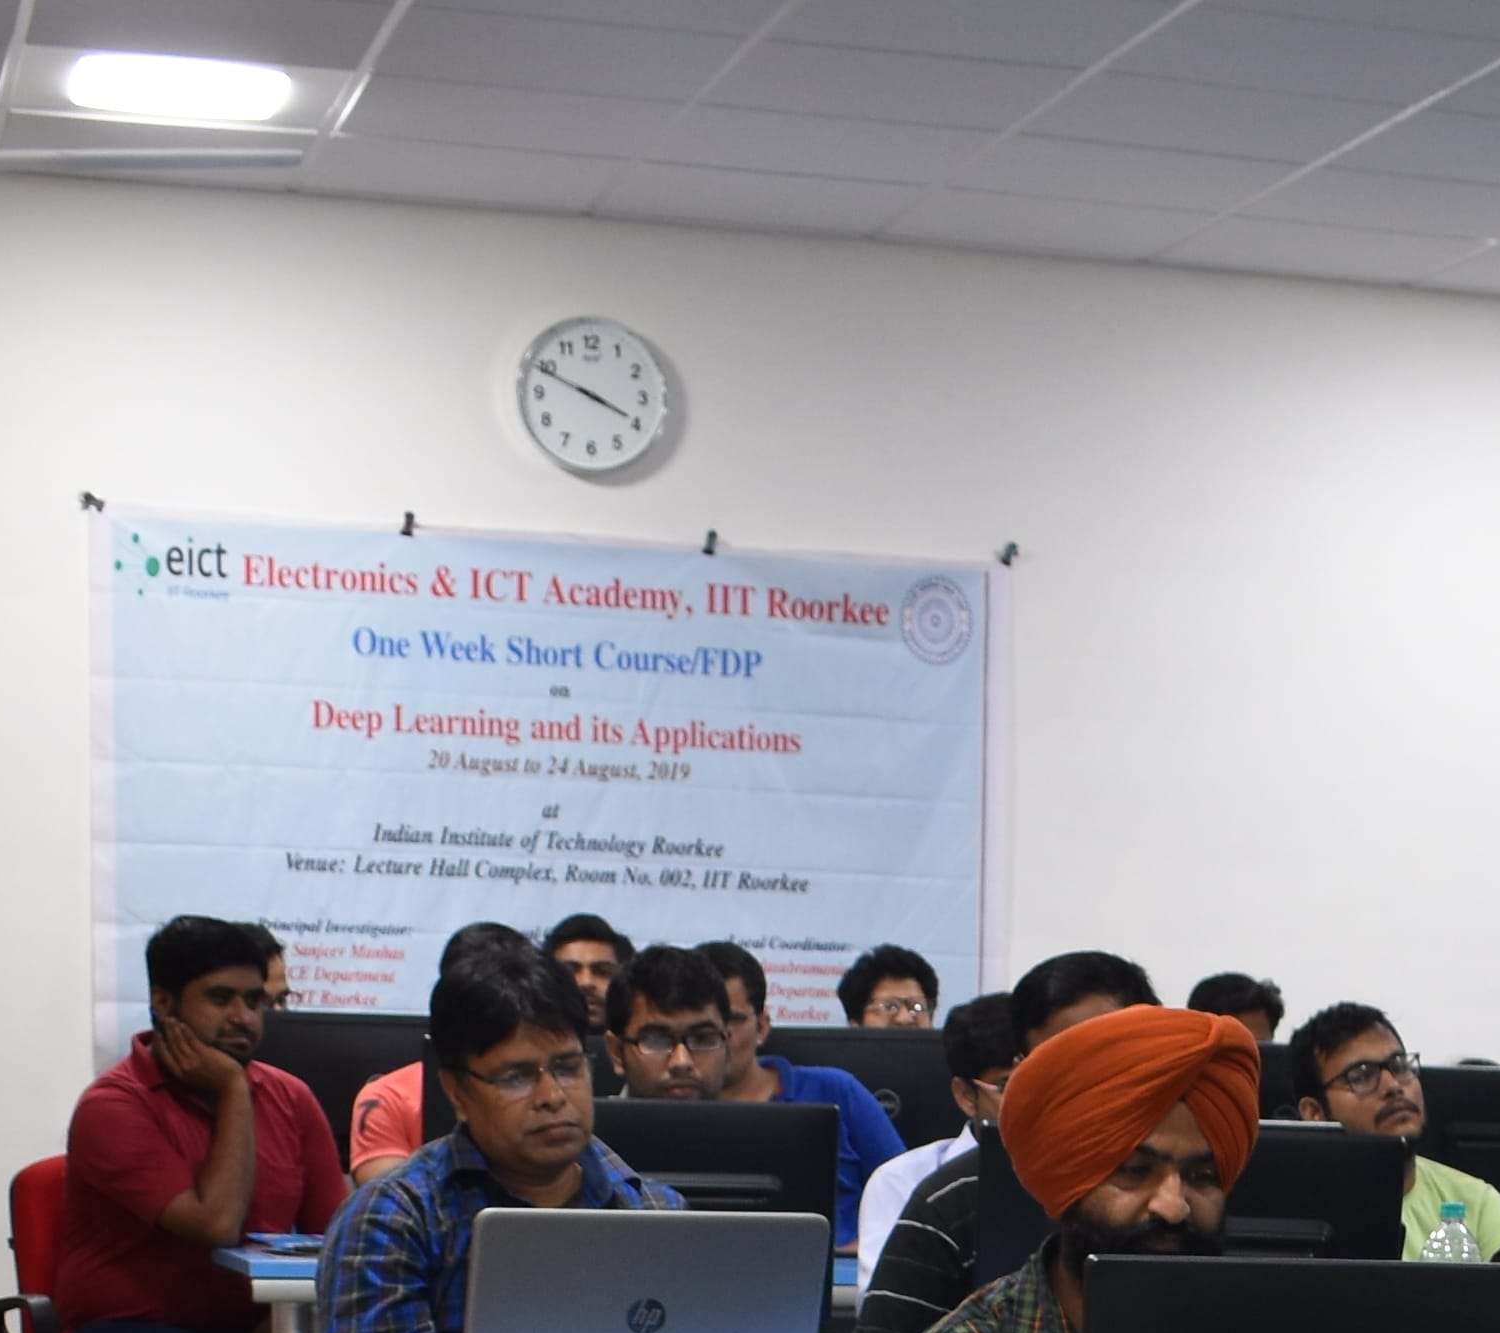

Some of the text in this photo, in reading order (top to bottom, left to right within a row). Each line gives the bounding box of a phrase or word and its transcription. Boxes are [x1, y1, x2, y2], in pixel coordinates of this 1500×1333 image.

[559, 341, 573, 355] 11
[583, 335, 599, 350] 12
[614, 343, 622, 358] 1
[631, 363, 641, 379] 2
[533, 384, 545, 400] 9
[637, 390, 648, 405] 3
[541, 411, 552, 427] 8
[631, 416, 641, 431] 4
[560, 431, 571, 447] 7
[612, 433, 623, 450] 5
[586, 440, 598, 456] 6
[166, 537, 228, 578] eict
[242, 553, 418, 596] Electronics
[430, 565, 457, 598] &
[470, 567, 532, 603] ICT
[544, 574, 694, 618] Academy,
[705, 582, 756, 617] IIT
[767, 588, 890, 627] Roorkee
[352, 625, 763, 679] One Week Short Course/FDP
[312, 699, 802, 755] Deep Learning and its Applications
[427, 749, 692, 783] 20 August to 24 August, 2019
[542, 802, 560, 821] at
[372, 824, 724, 859] Indian Institute of Technology Roorkee
[285, 852, 809, 894] Venue: Lecture Hall Complex, Room No. 002, IIT Roorkee
